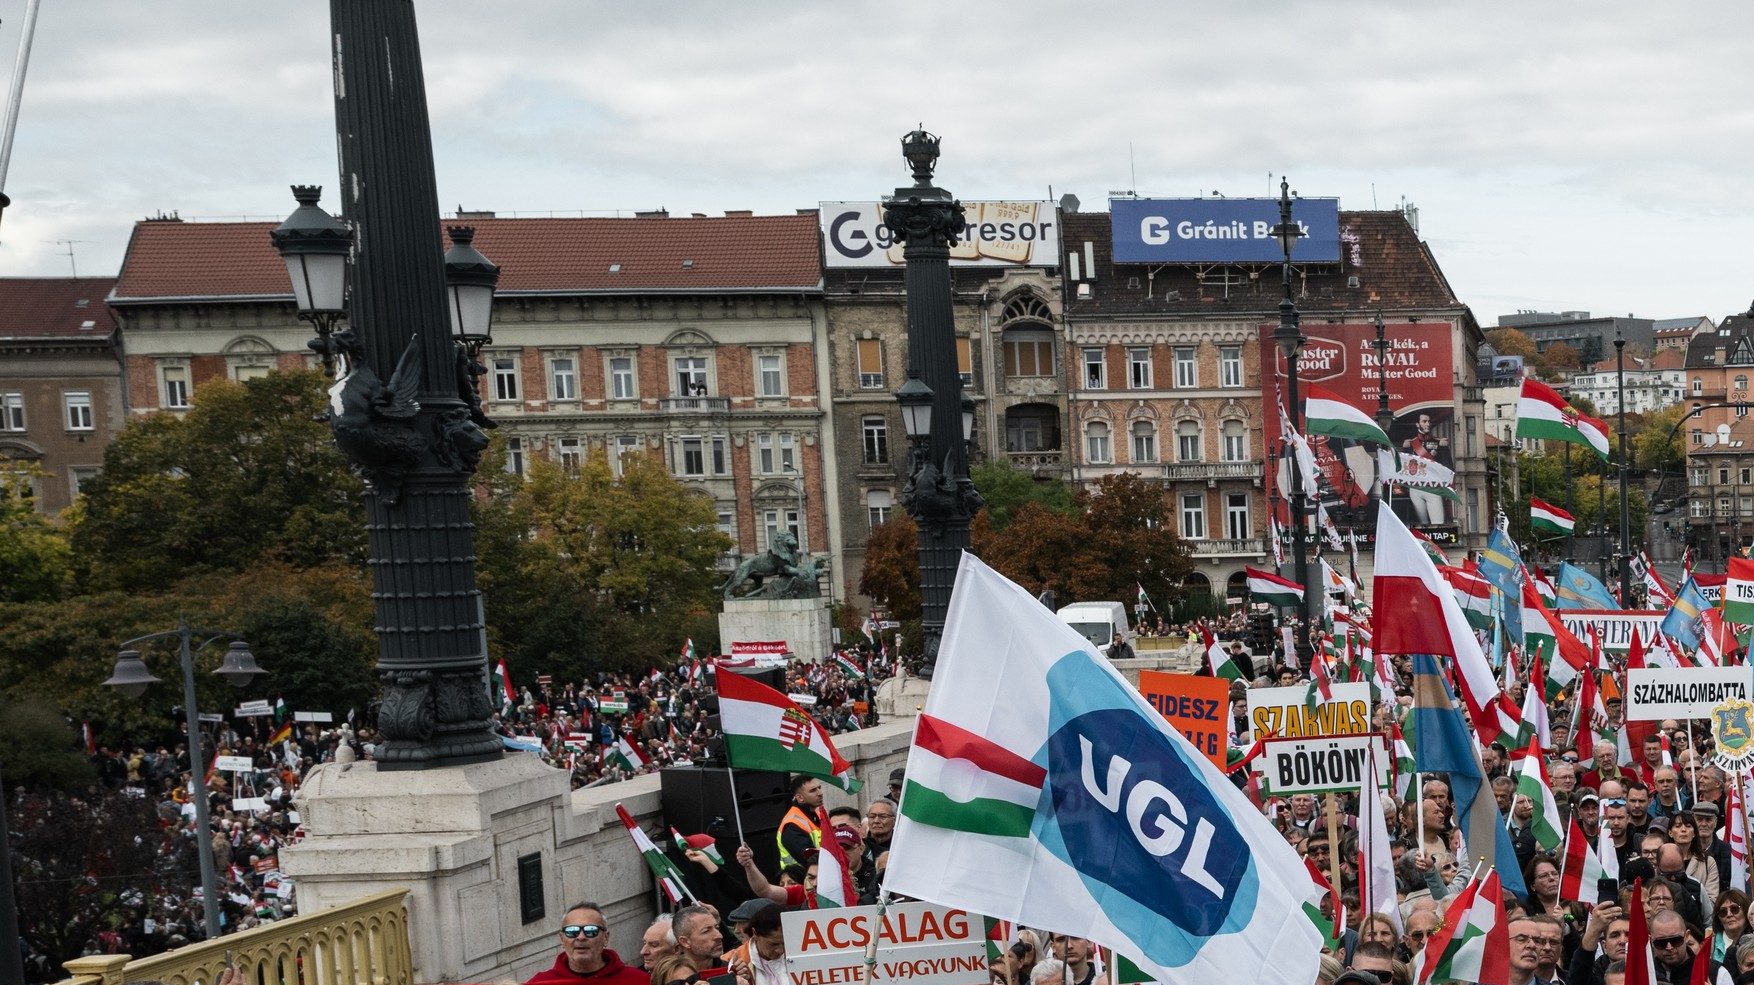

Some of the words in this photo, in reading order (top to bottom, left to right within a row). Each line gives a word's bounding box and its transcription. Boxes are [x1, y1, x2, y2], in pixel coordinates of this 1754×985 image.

[1177, 220, 1247, 239] Gránit
[1254, 220, 1309, 239] Bk
[1405, 367, 1437, 378] Good
[1634, 679, 1746, 705] SZÁZHALOMBATTA
[1079, 733, 1225, 900] UGL
[801, 909, 969, 952] ACSALAG
[883, 955, 987, 981] VAGYUNK
